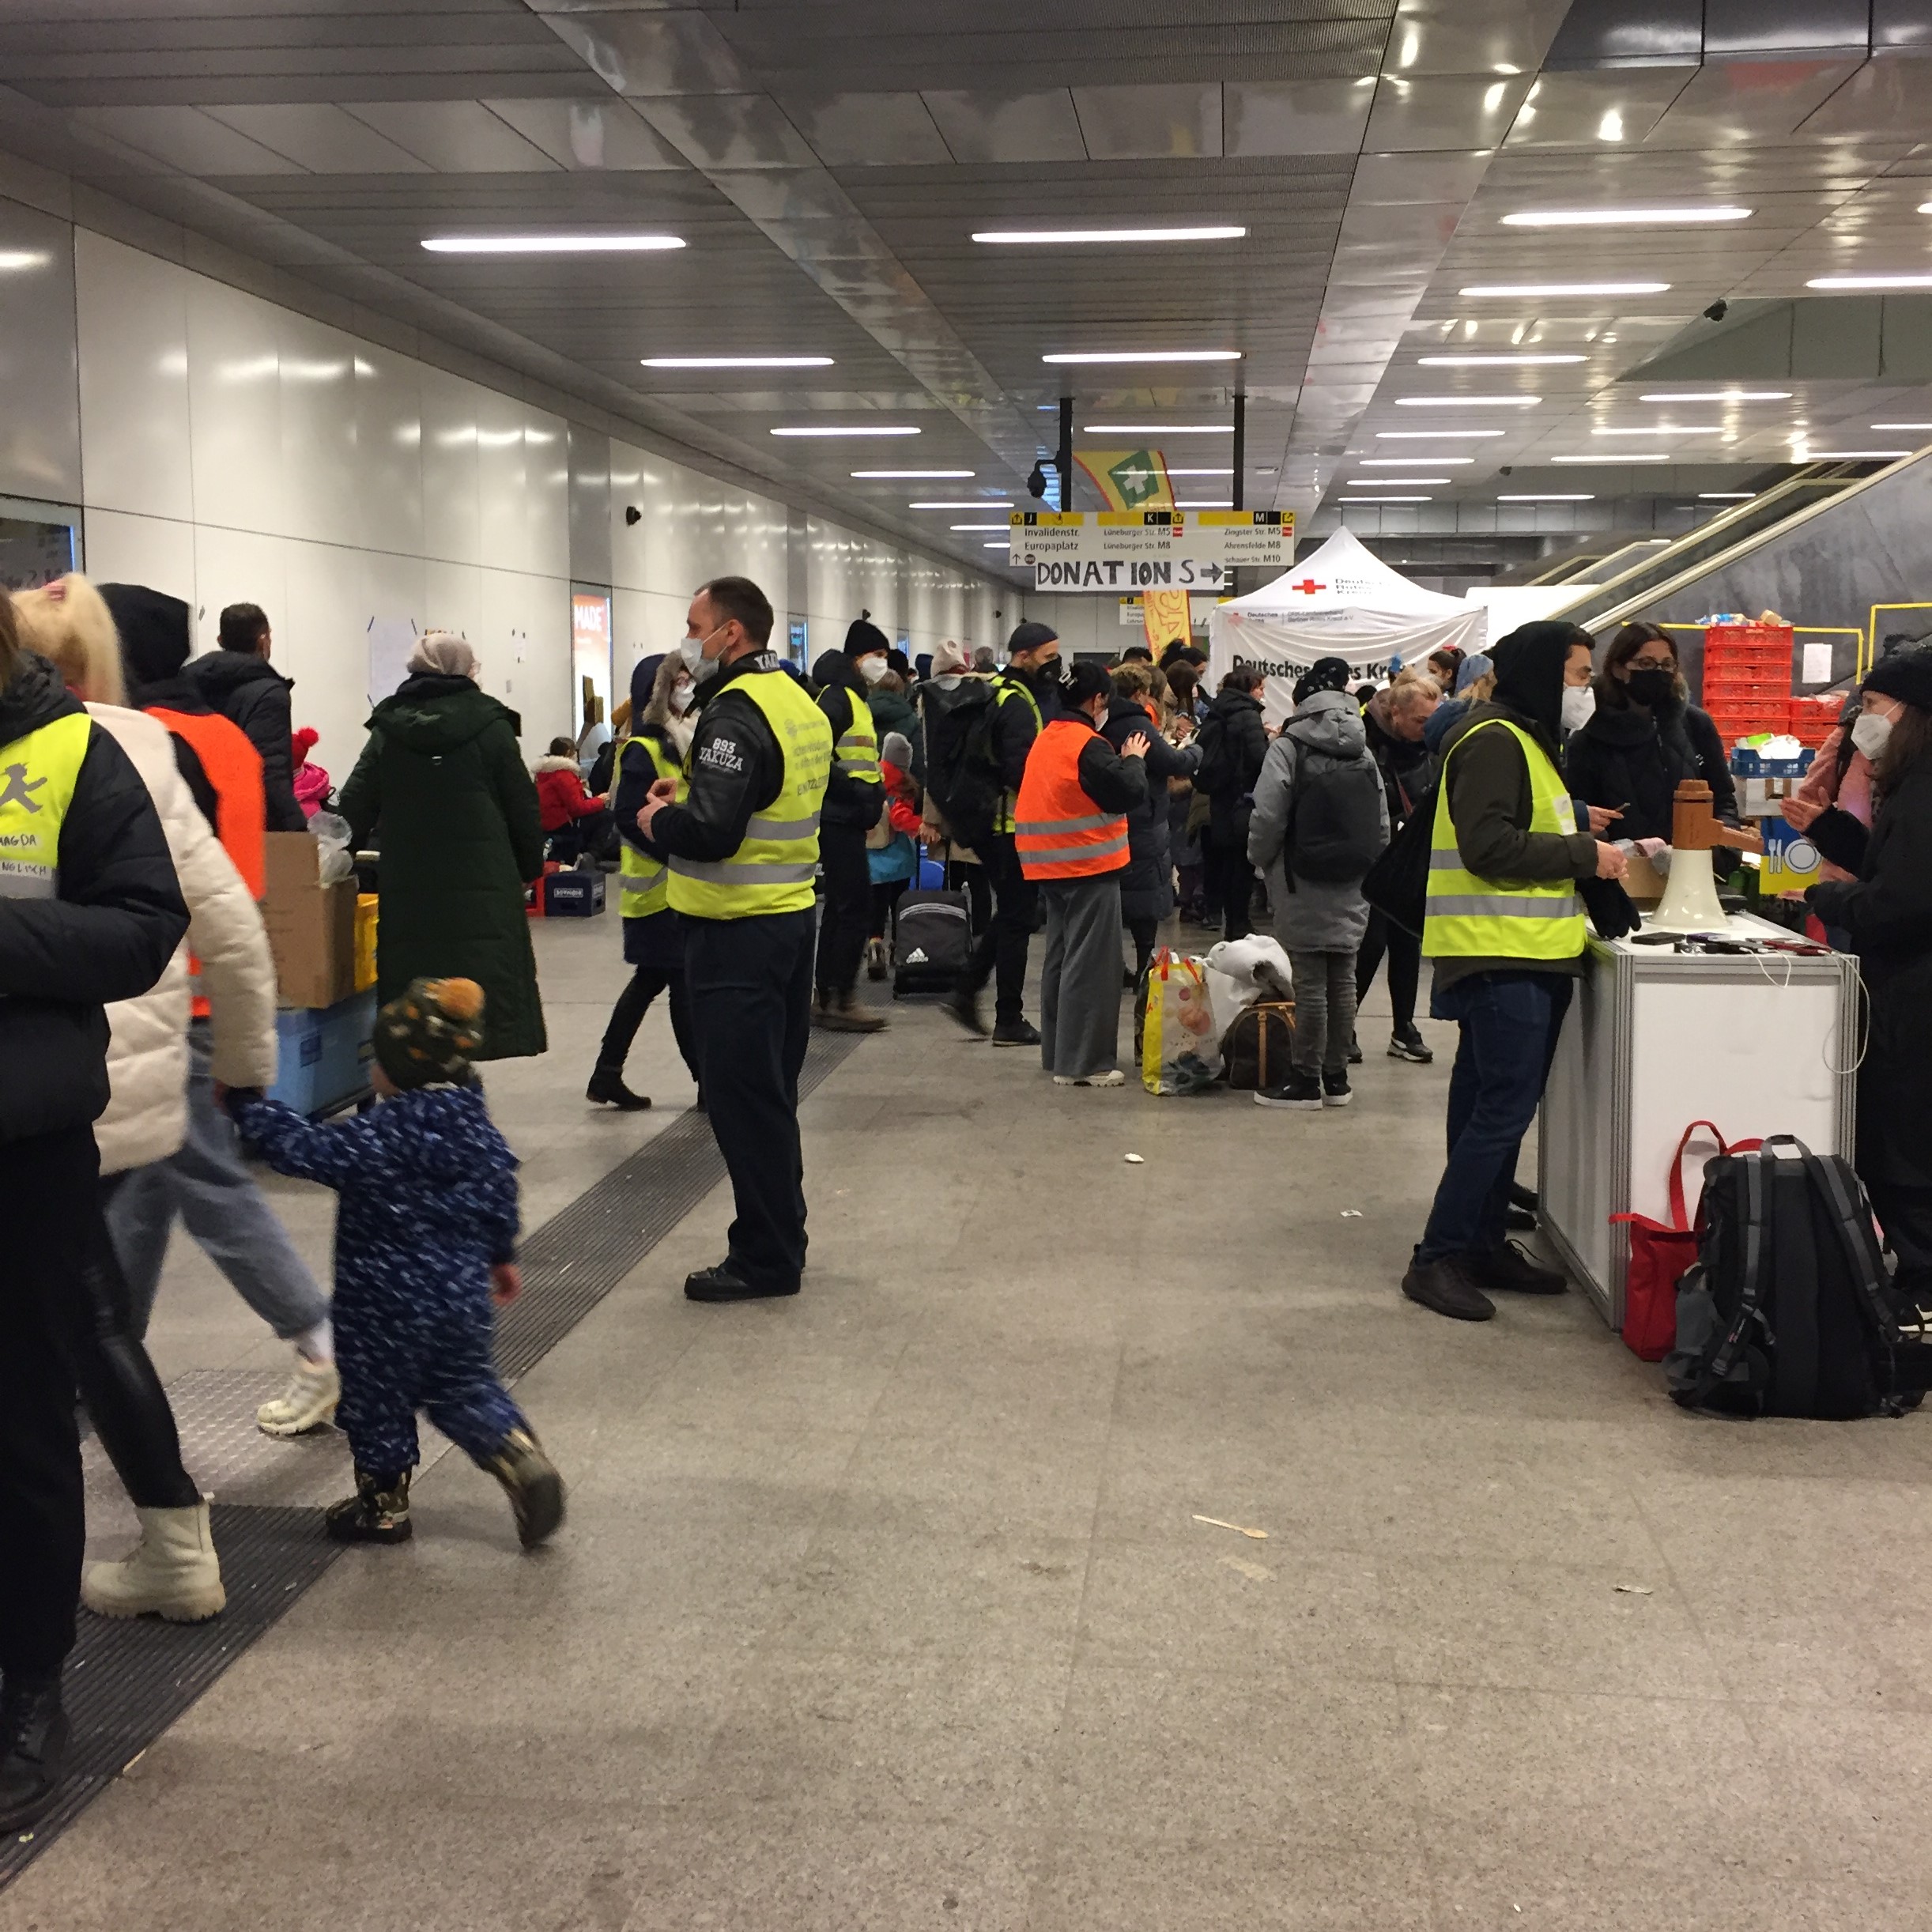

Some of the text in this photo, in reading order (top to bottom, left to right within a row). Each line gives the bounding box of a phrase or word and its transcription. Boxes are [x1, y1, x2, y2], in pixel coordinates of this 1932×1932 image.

[1028, 514, 1032, 523] J
[1147, 514, 1153, 523] K
[1255, 513, 1265, 522] M
[1024, 528, 1079, 537] Invalidenstr.
[1158, 527, 1171, 536] M5
[1024, 541, 1079, 552] Europaplatz
[1267, 541, 1281, 549] M8
[712, 738, 737, 754] 893
[699, 746, 744, 772] YAKUZA
